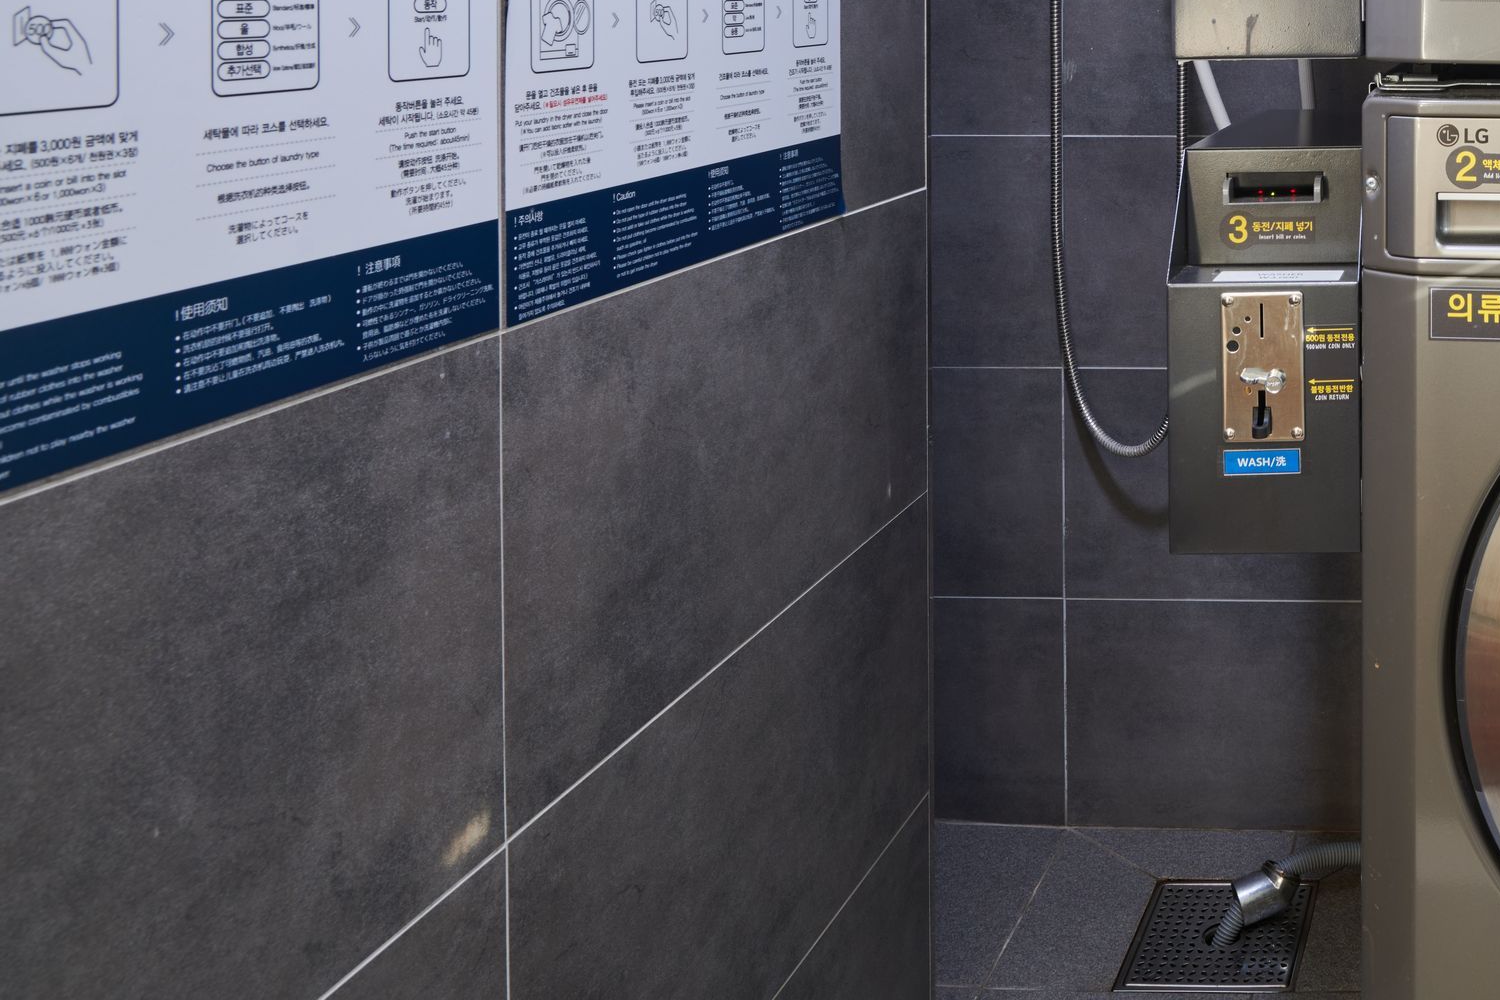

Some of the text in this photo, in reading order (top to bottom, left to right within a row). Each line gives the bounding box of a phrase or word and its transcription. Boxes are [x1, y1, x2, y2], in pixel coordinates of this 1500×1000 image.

[203, 127, 238, 140] 세탁물에
[242, 125, 259, 136] 따라
[262, 121, 285, 133] 코스를
[1464, 129, 1488, 143] LG
[207, 163, 234, 173] Choose
[249, 157, 270, 167] button
[281, 153, 303, 163] laundry
[306, 151, 319, 159] type
[1456, 151, 1476, 181] 2
[1229, 216, 1248, 243] 3
[1252, 222, 1312, 231] 동전/지폐 넣기
[1237, 456, 1286, 467] WASH/洗
